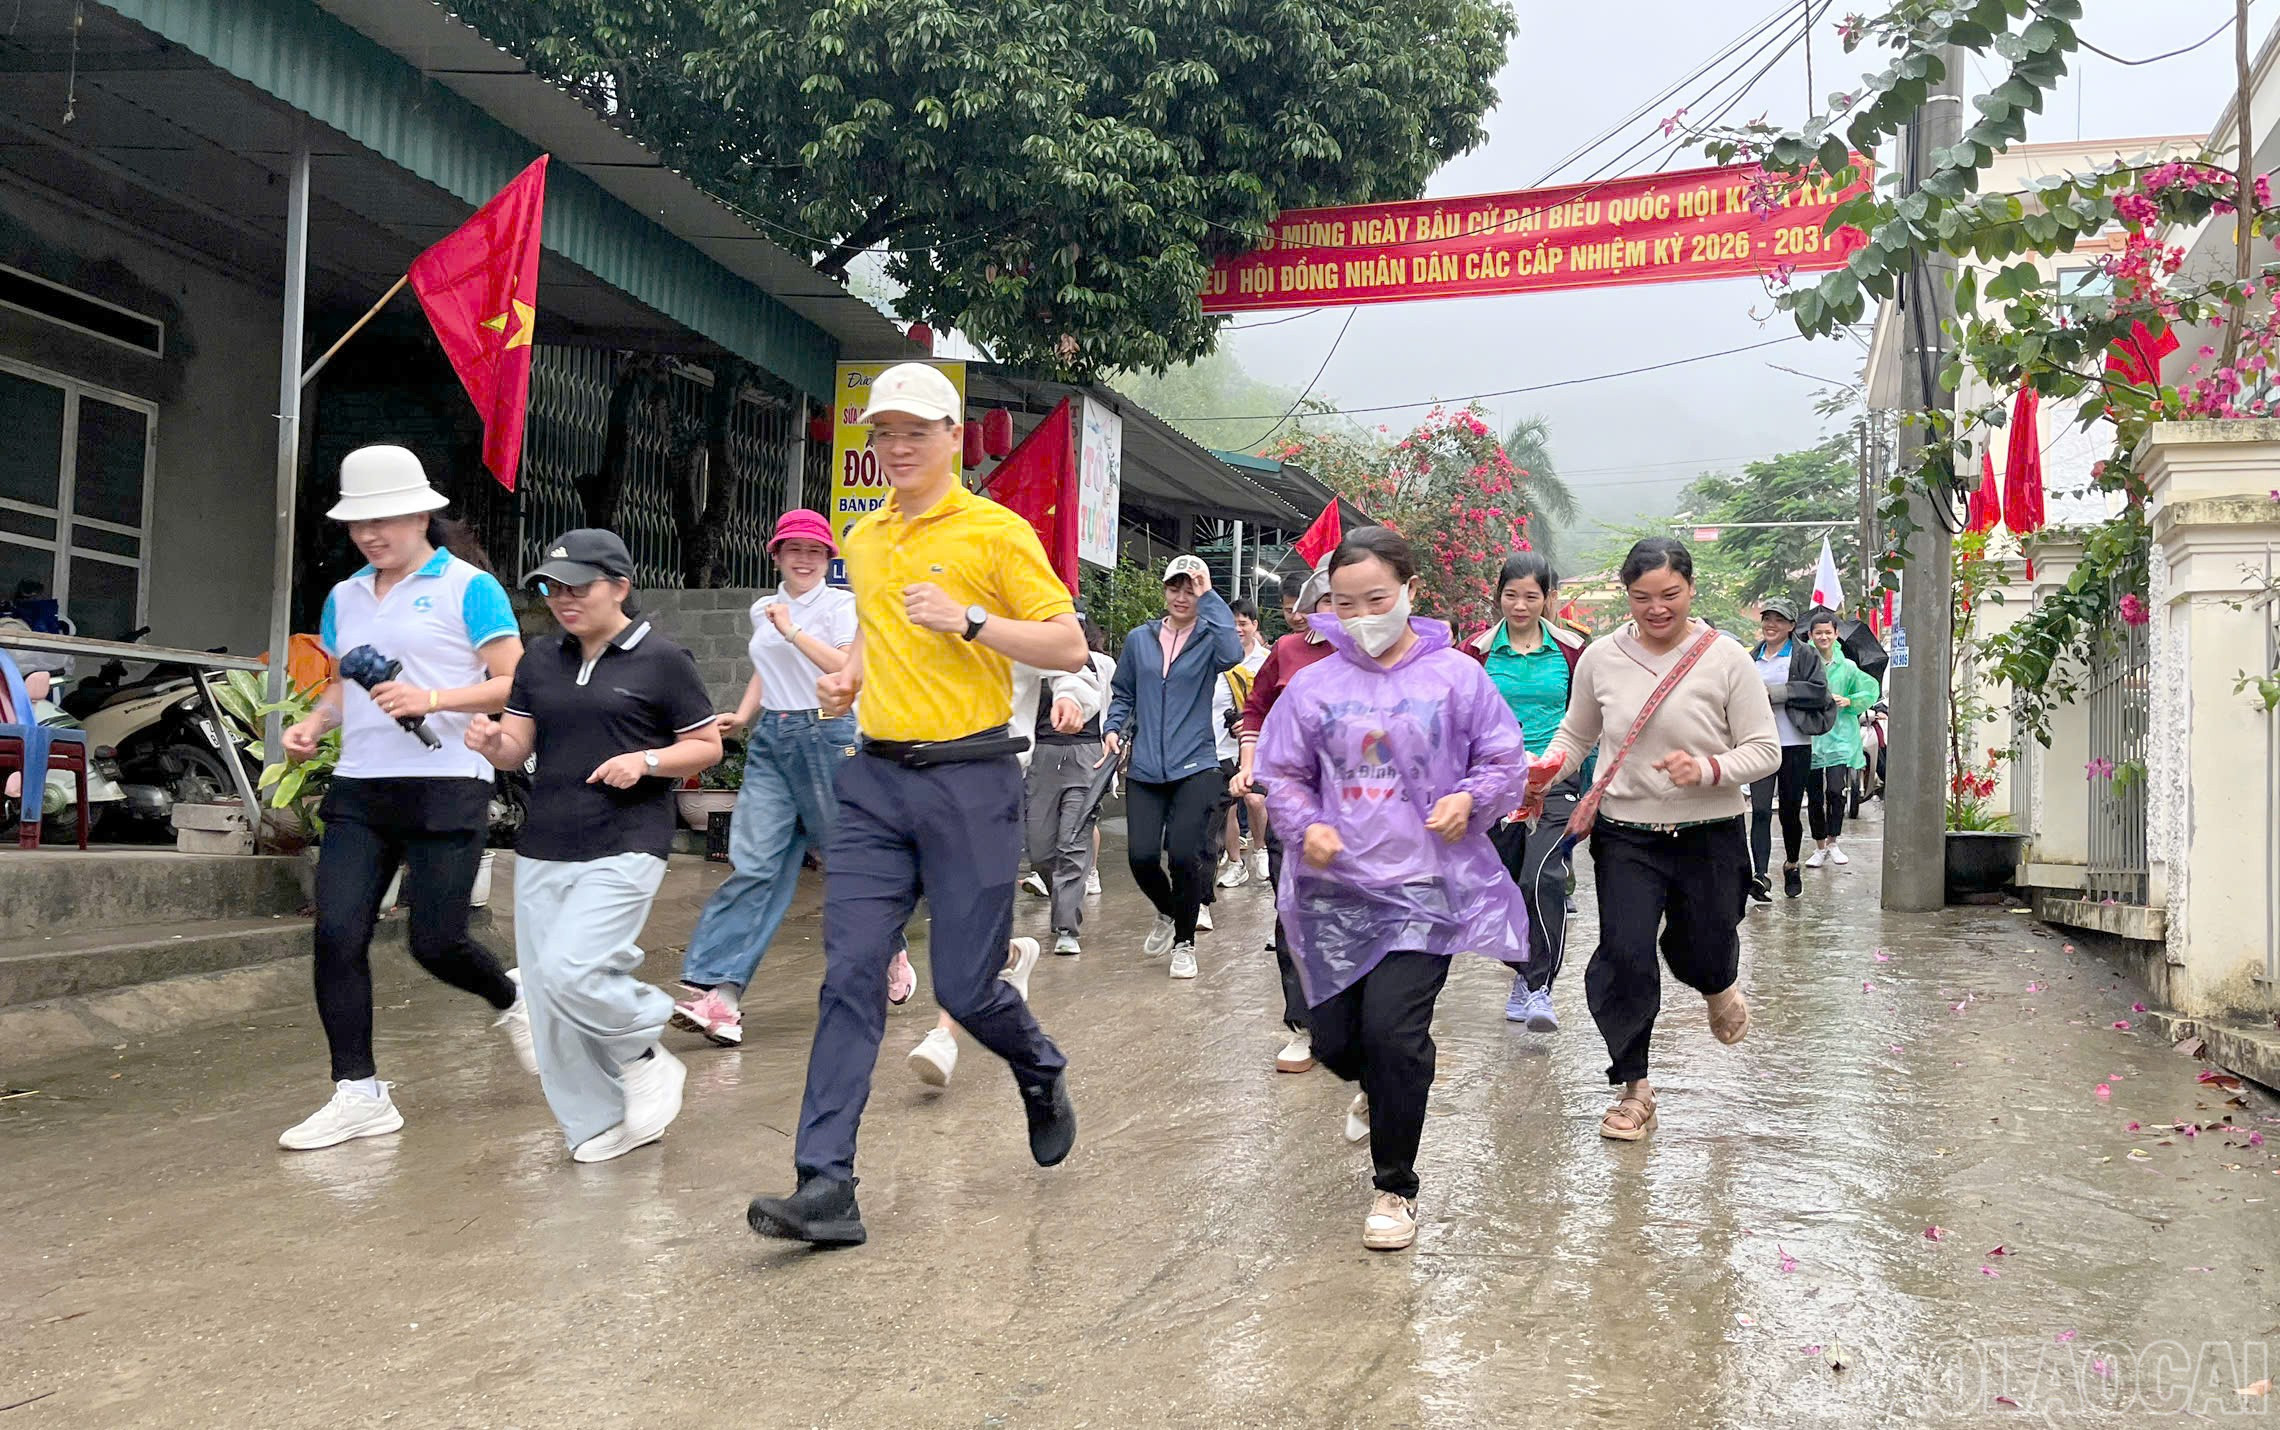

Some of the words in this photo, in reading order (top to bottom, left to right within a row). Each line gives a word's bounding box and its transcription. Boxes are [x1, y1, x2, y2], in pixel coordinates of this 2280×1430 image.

[1281, 218, 1346, 250] MỪNG
[1351, 213, 1410, 246] NGÀY
[1468, 202, 1499, 237] CỬ
[1503, 206, 1542, 237] ĐẠI
[1608, 186, 1671, 226] QUỐC
[1678, 185, 1718, 222] HỘI
[1240, 262, 1274, 299] HỘI
[1280, 256, 1339, 292] ĐỒNG
[1345, 254, 1406, 288] NHÂN
[1412, 251, 1459, 284] DÂN
[1465, 247, 1510, 280] CÁC
[1517, 238, 1563, 277] CẤP
[1570, 236, 1647, 275] NHIỆM
[1654, 232, 1685, 265] KỲ
[1690, 231, 1750, 262] 2026
